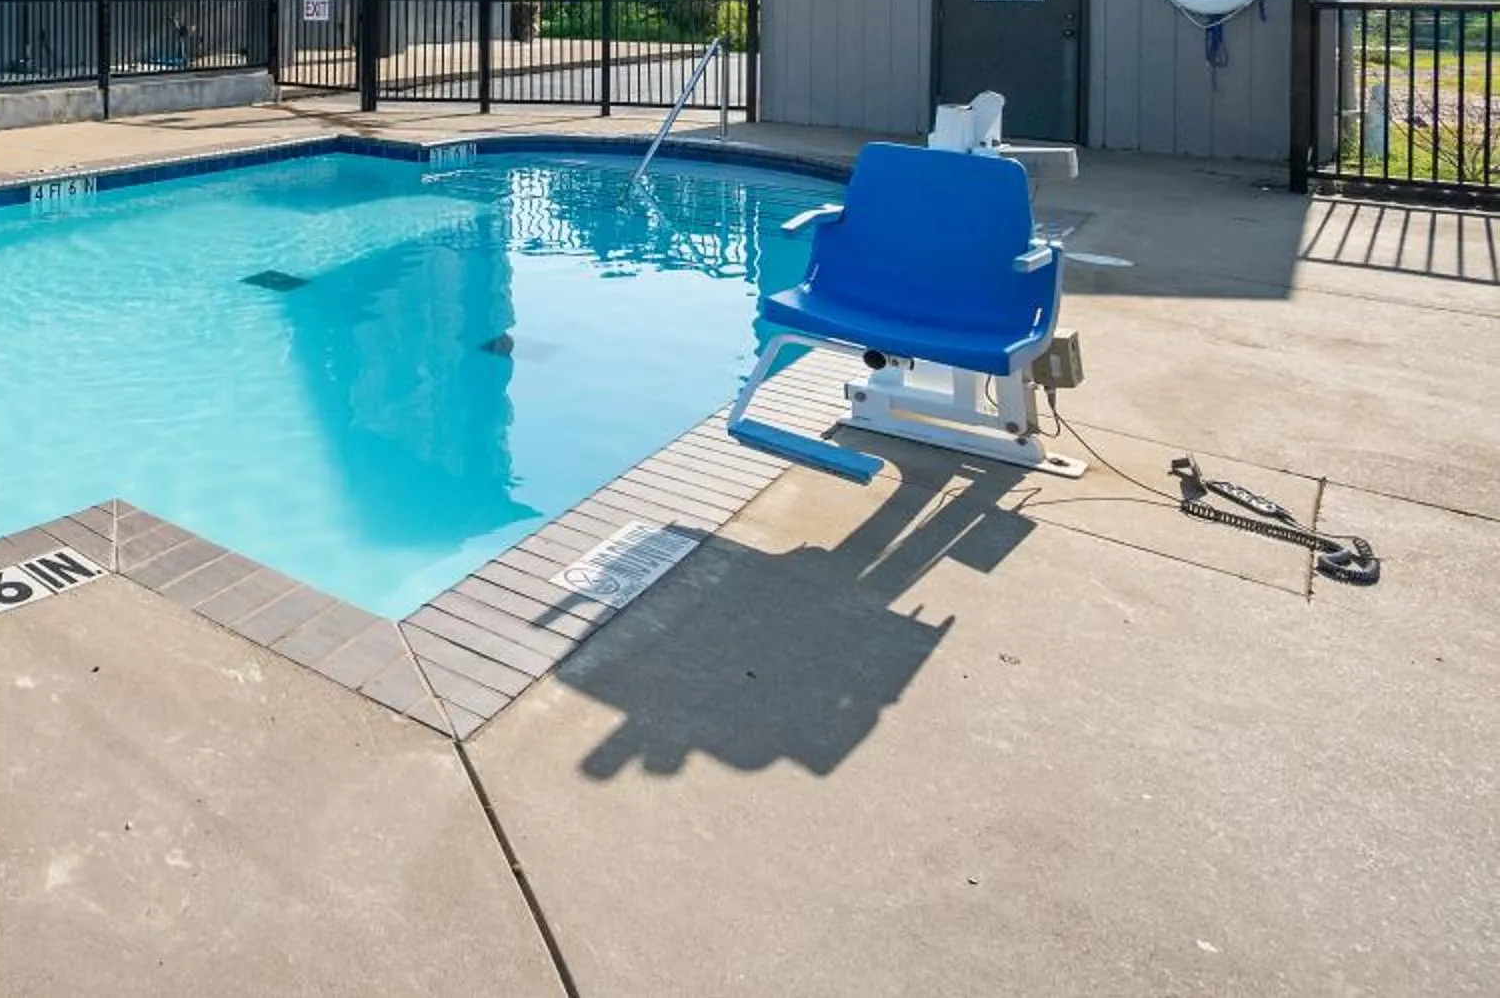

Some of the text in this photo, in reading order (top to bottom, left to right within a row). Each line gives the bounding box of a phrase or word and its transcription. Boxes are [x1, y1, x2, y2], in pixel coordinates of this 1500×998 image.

[305, 1, 326, 16] EXIT
[35, 185, 43, 199] 4
[69, 181, 77, 195] 6
[23, 551, 102, 589] IN.
